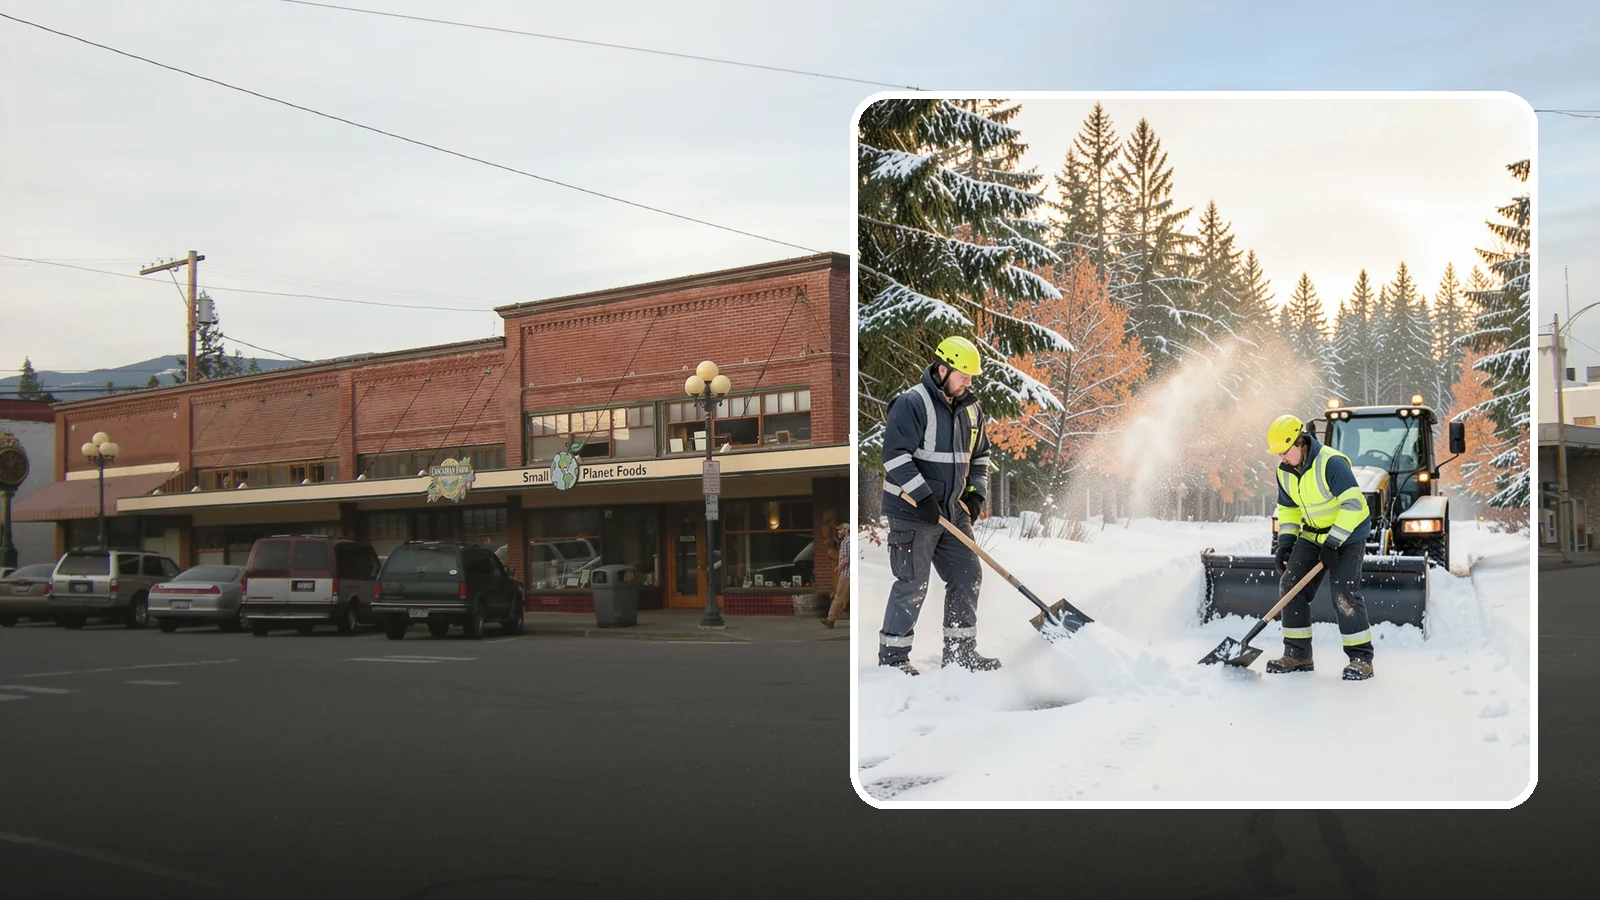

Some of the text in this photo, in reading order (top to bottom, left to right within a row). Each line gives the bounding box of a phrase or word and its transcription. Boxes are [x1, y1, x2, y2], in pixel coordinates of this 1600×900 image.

[523, 464, 647, 483] Small Planet Foods
